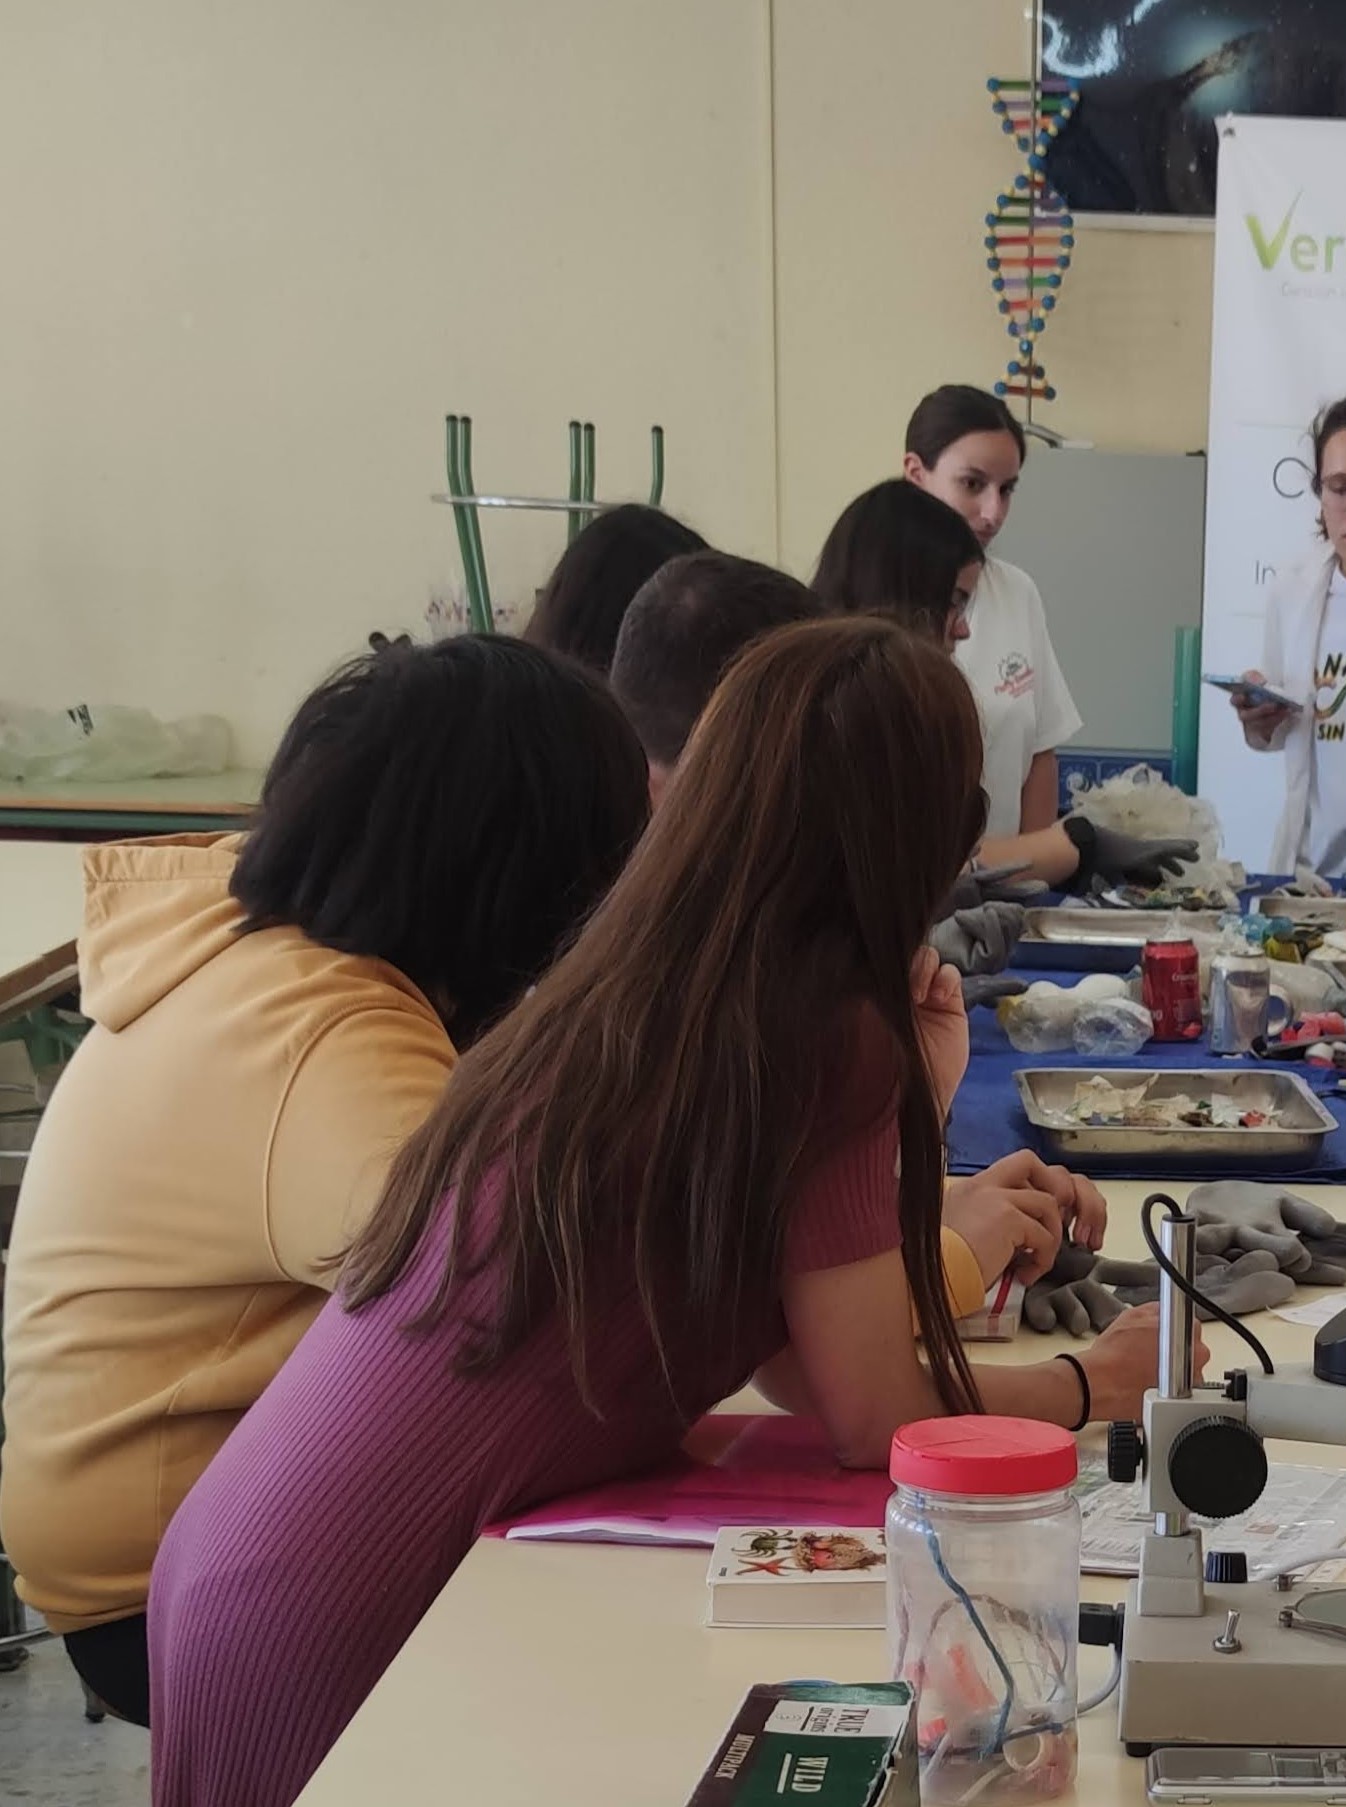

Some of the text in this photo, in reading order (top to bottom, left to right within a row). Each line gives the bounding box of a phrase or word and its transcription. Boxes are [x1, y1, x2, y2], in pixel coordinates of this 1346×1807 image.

[1317, 722, 1345, 741] SIN
[834, 1707, 870, 1735] TRUE
[714, 1733, 756, 1780] MULTIPACK
[791, 1757, 830, 1793] WILD
